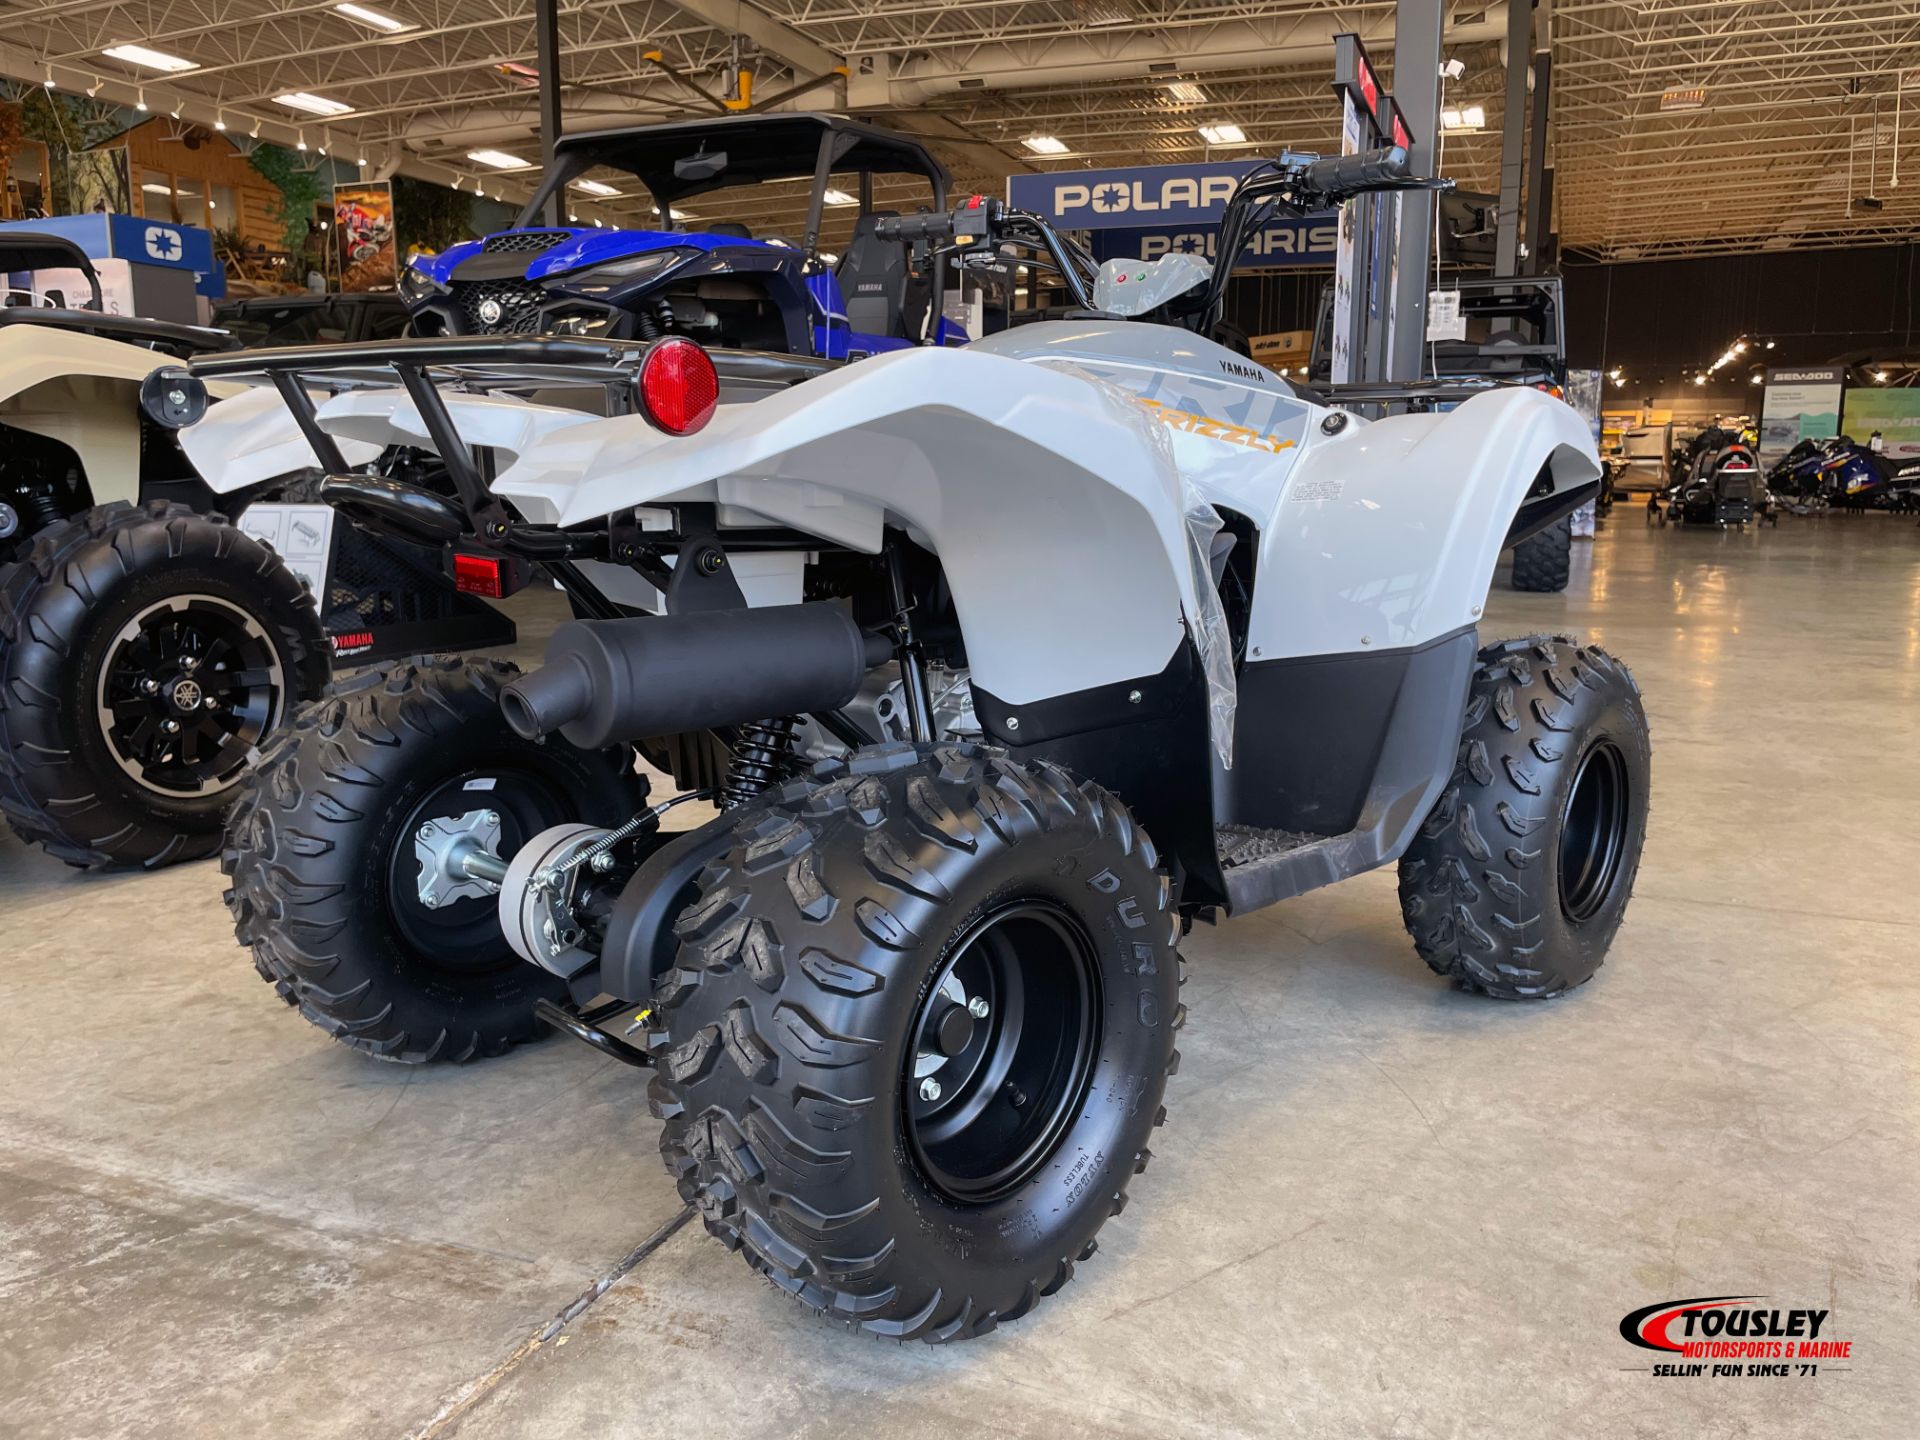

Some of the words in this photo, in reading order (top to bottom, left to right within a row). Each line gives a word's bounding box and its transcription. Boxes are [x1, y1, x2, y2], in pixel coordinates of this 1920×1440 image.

[1054, 173, 1292, 216] POLAR
[858, 283, 882, 291] YAMAHA
[1219, 359, 1265, 383] YAMAHA
[338, 632, 374, 648] YAMAHA
[1087, 866, 1160, 1028] DURO
[1063, 1153, 1090, 1187] TUBELESS
